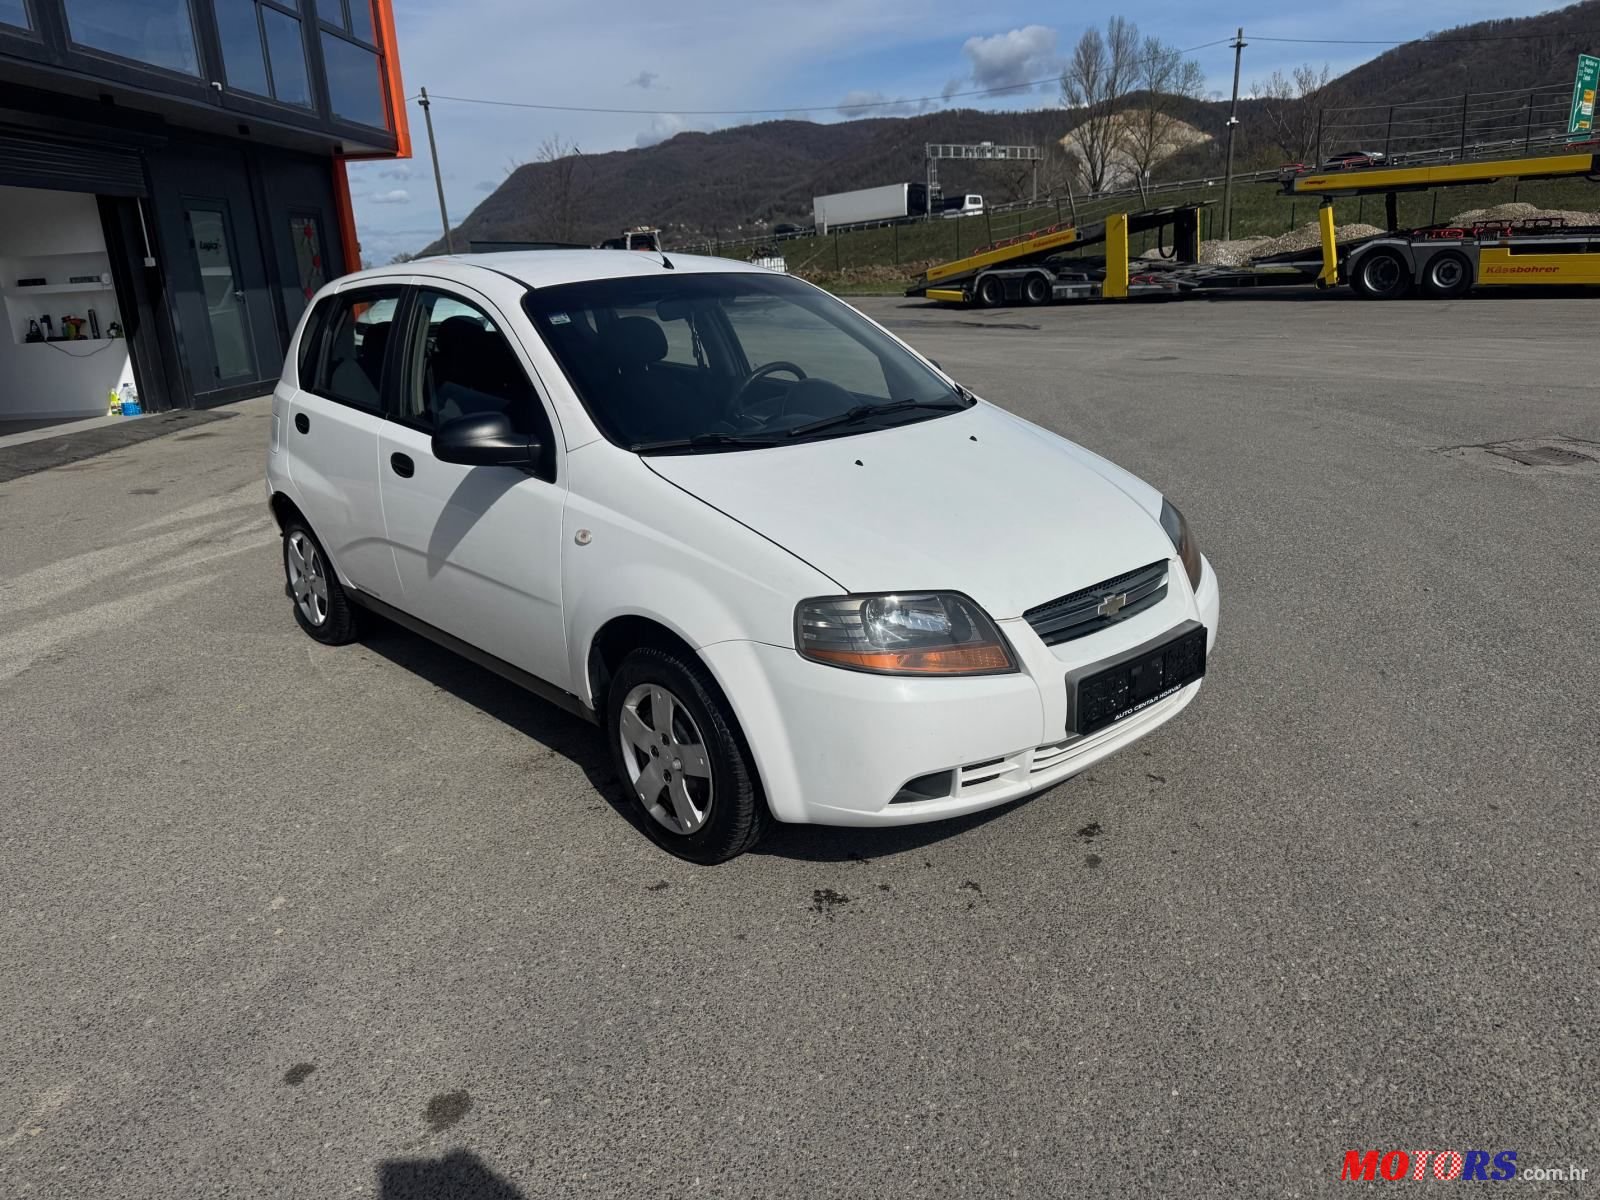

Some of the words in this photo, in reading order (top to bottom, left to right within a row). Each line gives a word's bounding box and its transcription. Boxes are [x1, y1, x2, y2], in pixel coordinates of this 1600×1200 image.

[1486, 265, 1560, 274] Kässbohrer
[1114, 708, 1133, 720] AUTO
[1133, 696, 1159, 711] CENTAR
